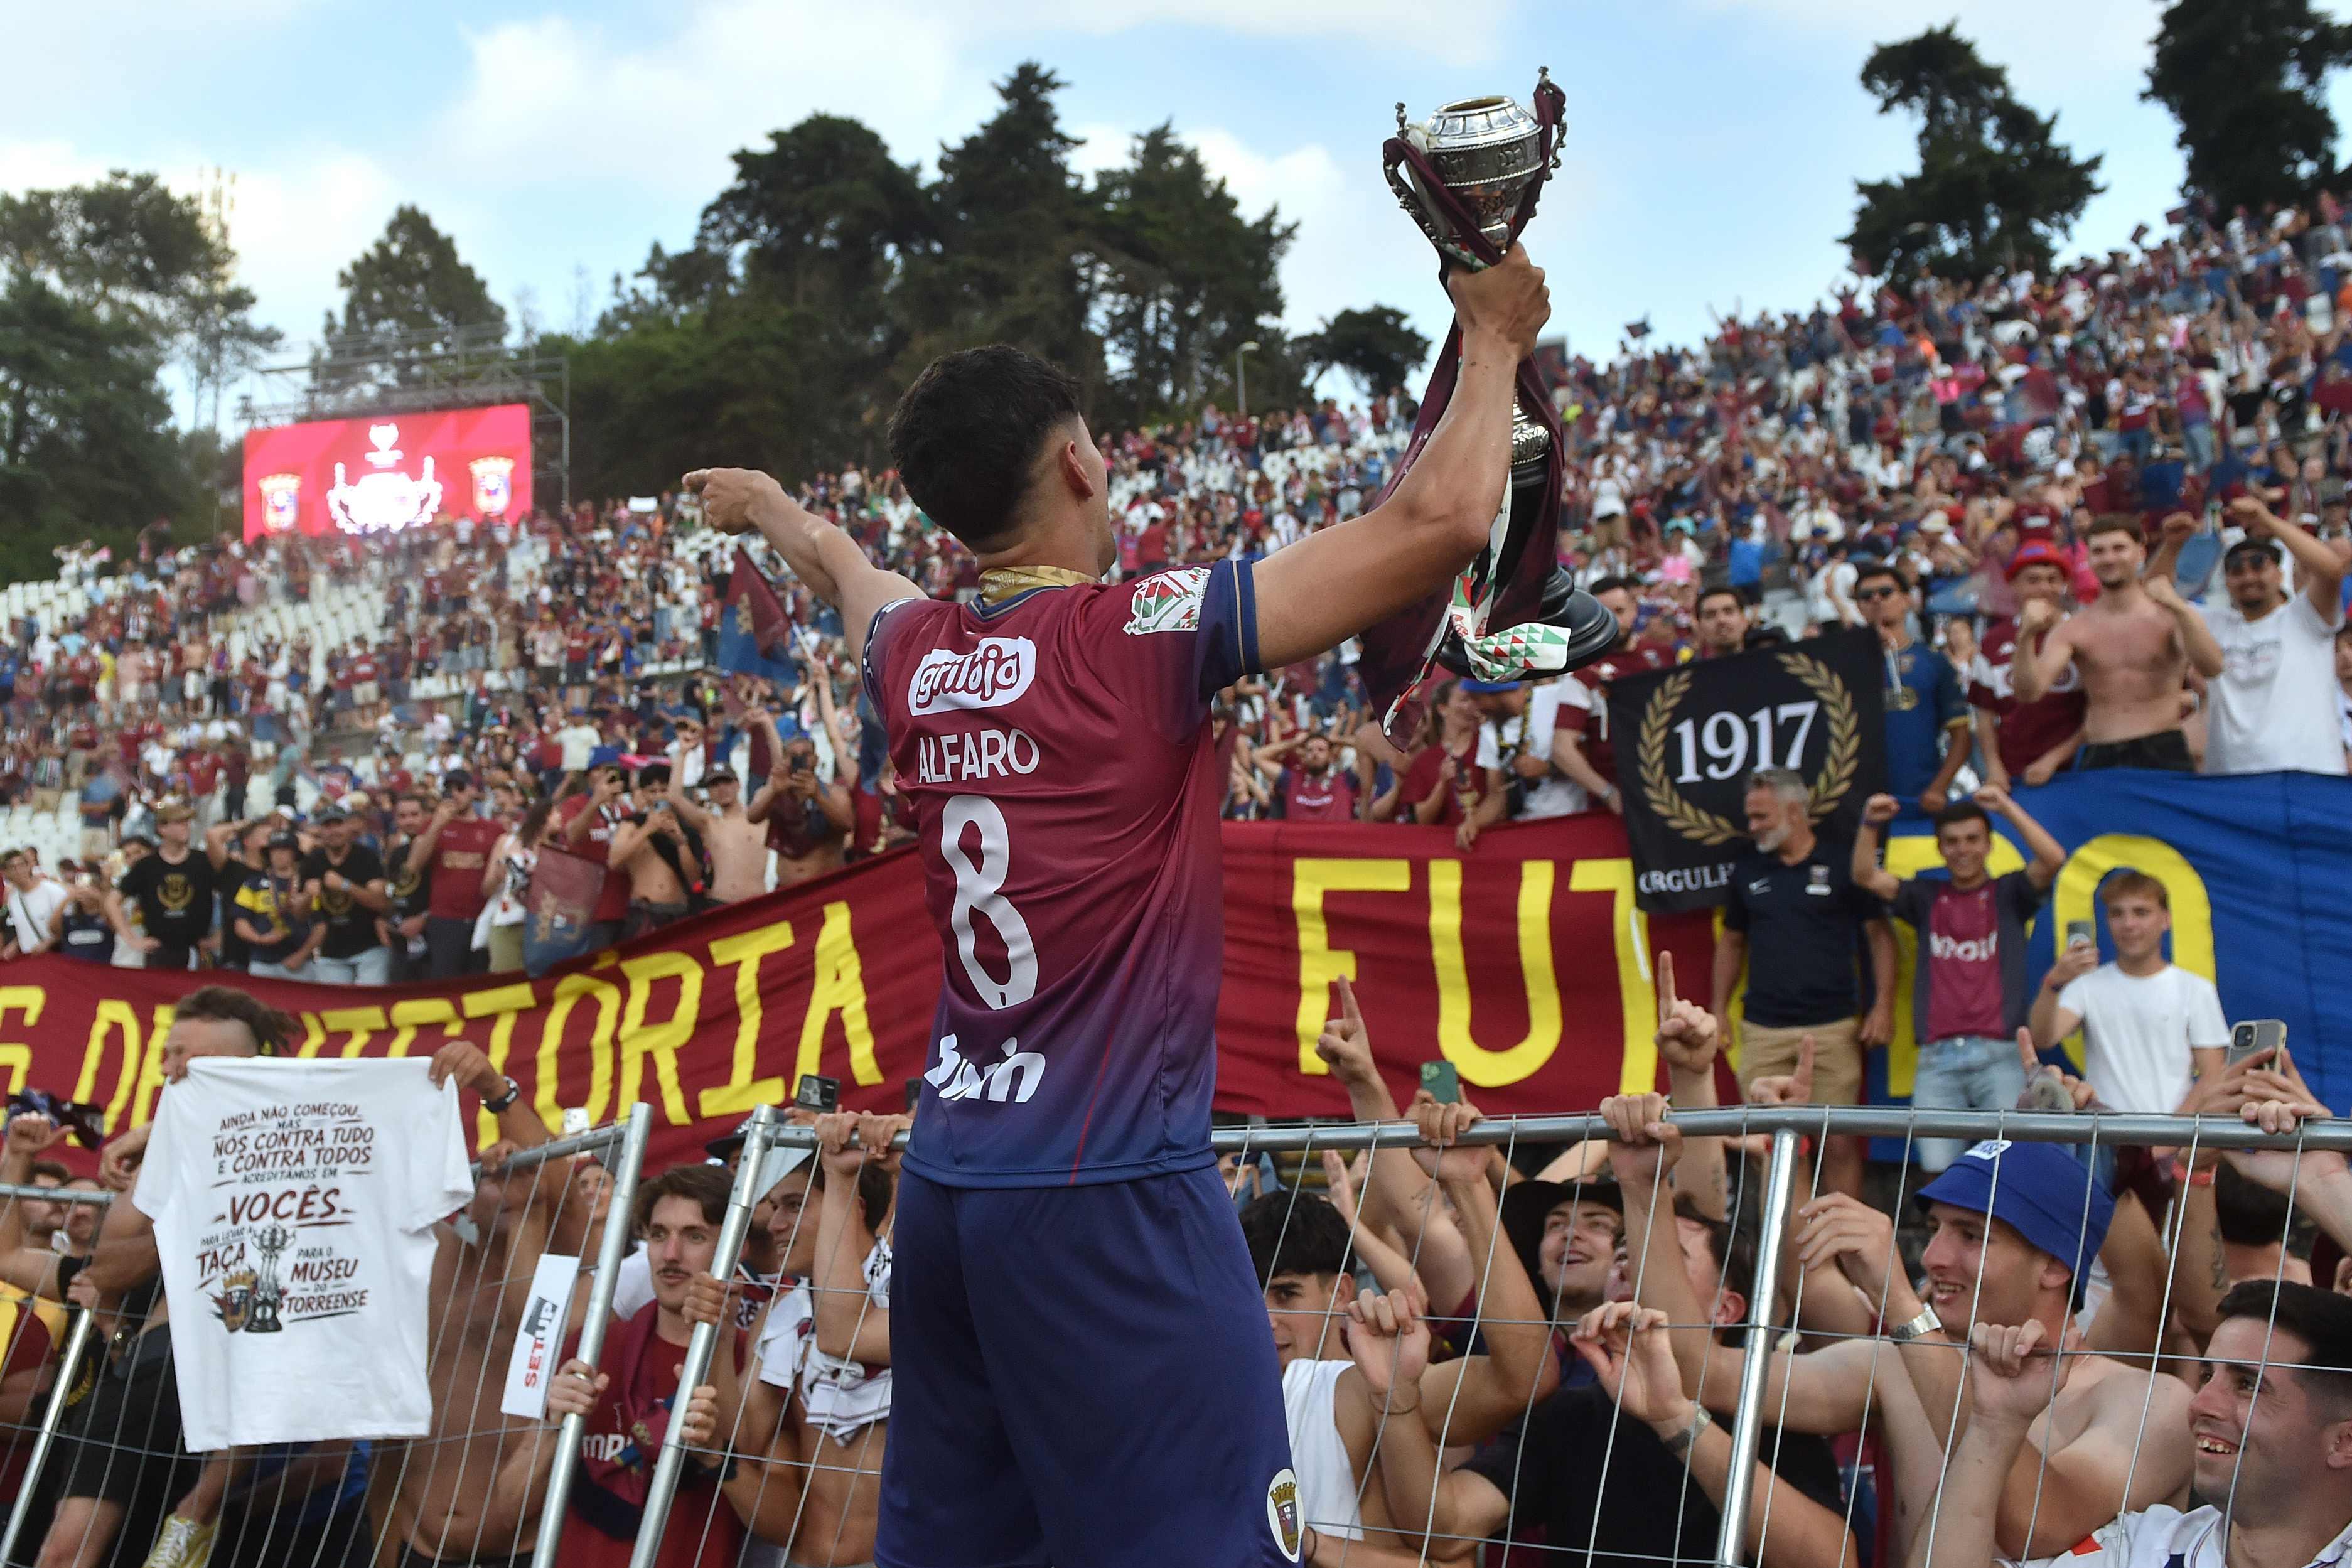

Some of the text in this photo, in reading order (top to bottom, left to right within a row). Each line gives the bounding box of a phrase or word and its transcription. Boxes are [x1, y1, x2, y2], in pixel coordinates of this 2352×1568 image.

[918, 728, 1040, 783] ALFARO
[1672, 700, 1819, 785] 1917
[942, 795, 1039, 1011] 8
[220, 1102, 359, 1130] AINDA NÃO COMEÇOU
[276, 1119, 301, 1129] MAS
[213, 1127, 374, 1159] NÓS CONTRA TUDO
[218, 1146, 372, 1175] E CONTRA TODOS
[241, 1168, 337, 1184] ACREDITAMOS EM
[230, 1184, 340, 1226] VOCÊS
[196, 1242, 245, 1278] TAÇA
[297, 1247, 321, 1258] PARA
[290, 1259, 358, 1283] MUSEU
[287, 1289, 369, 1314] TORREENSE
[524, 1301, 557, 1388] SETUP
